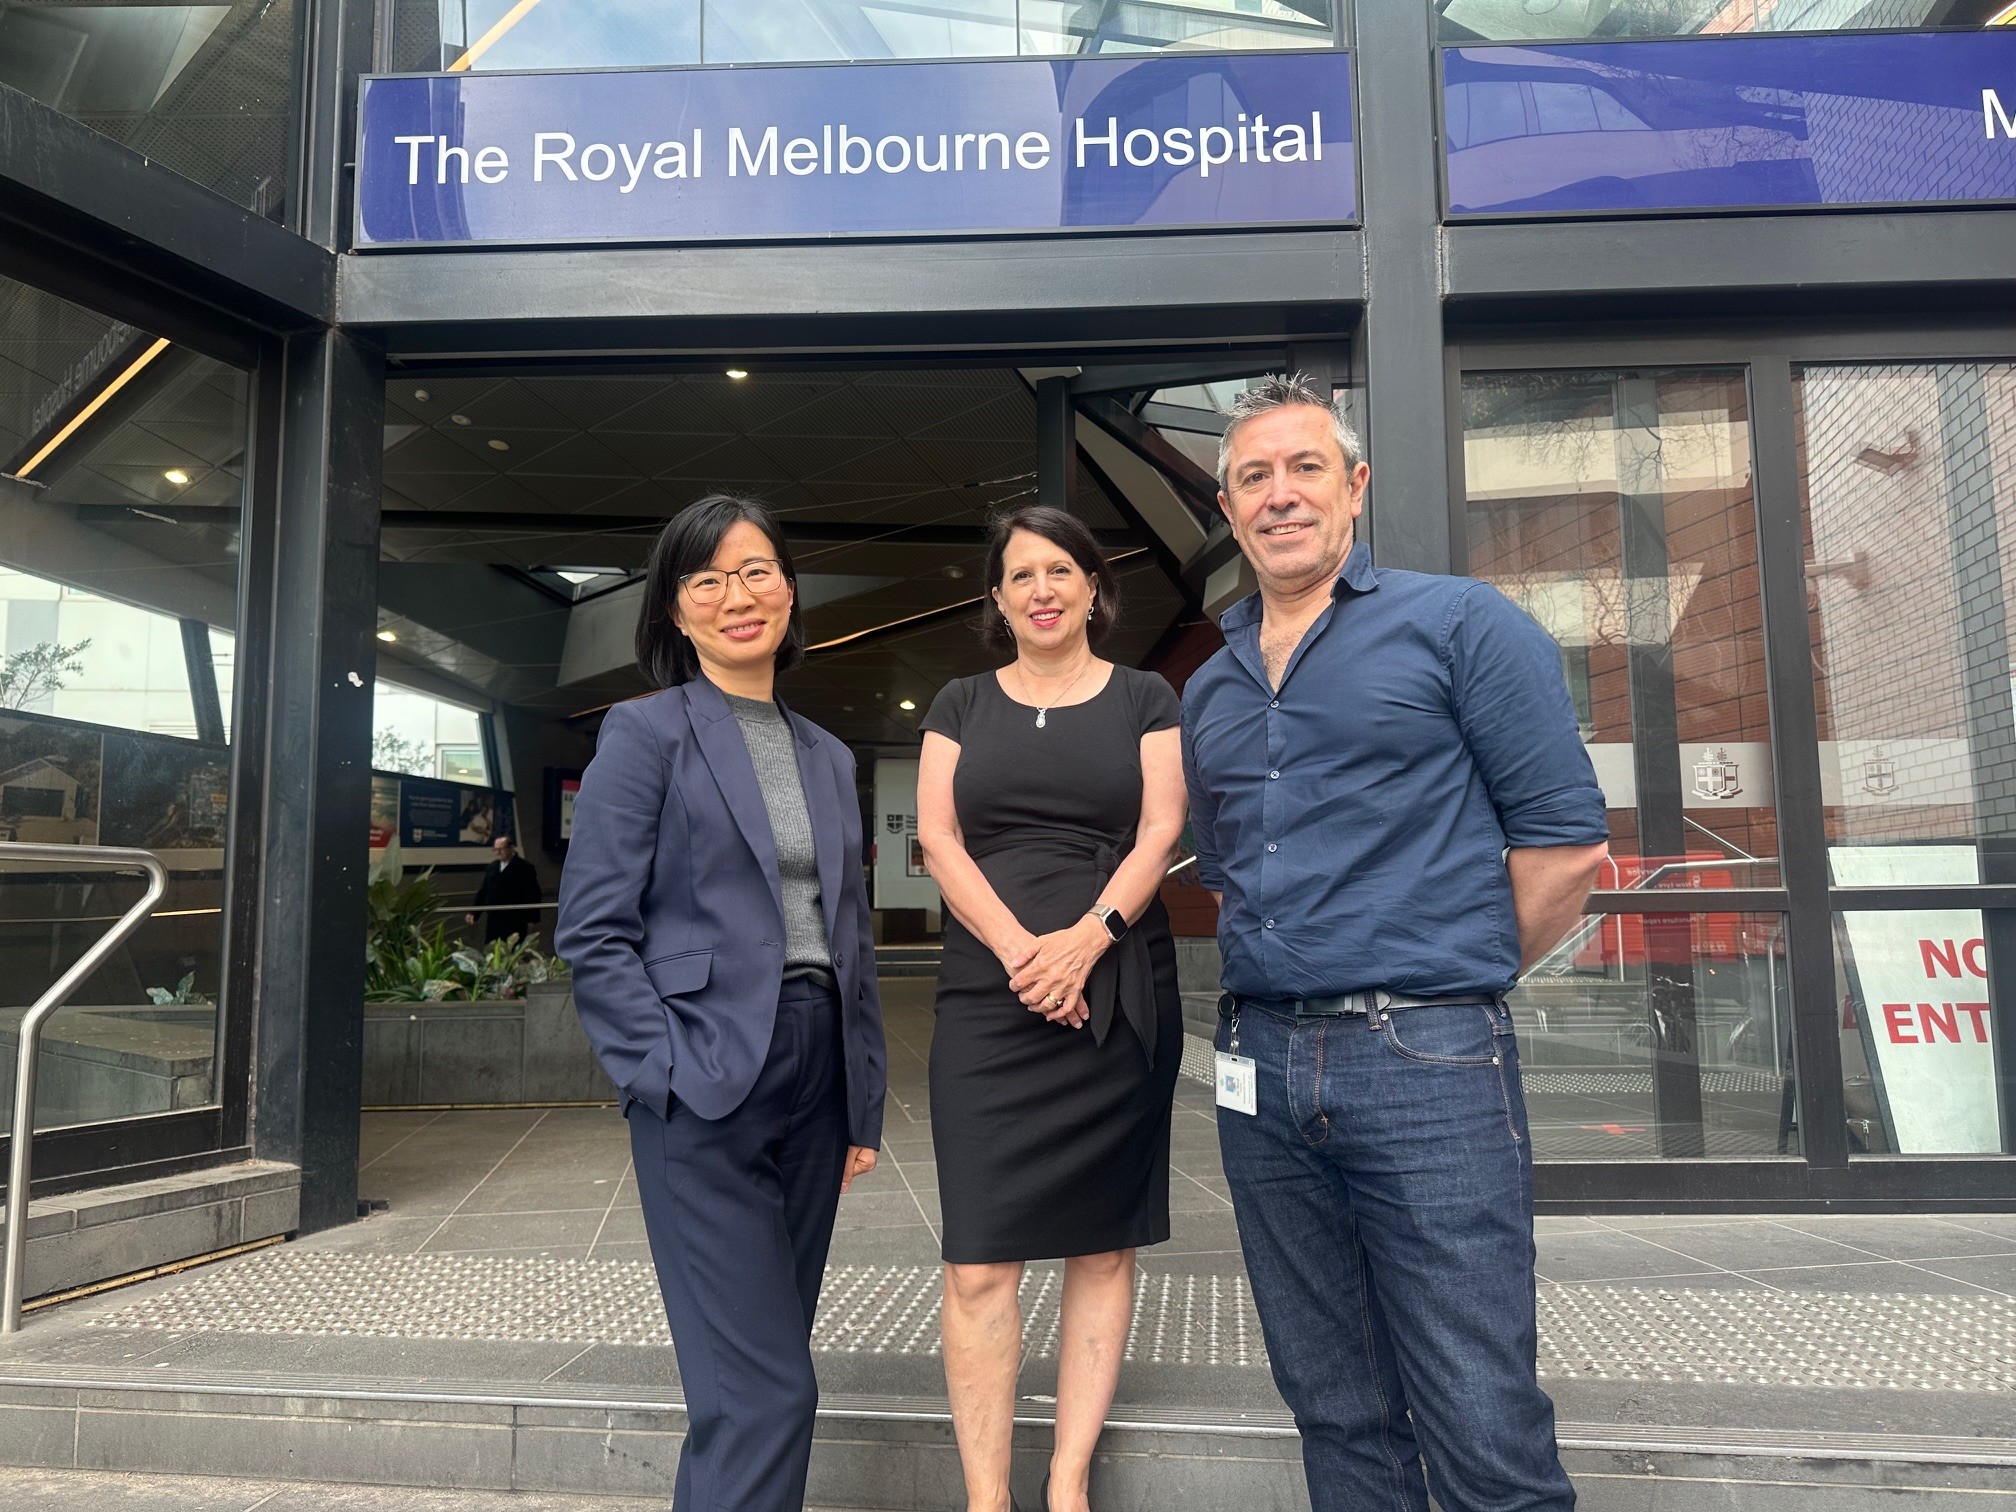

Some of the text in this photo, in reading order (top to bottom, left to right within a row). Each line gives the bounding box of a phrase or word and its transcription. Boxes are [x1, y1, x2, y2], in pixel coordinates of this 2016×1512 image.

[1981, 88, 2016, 139] M
[394, 110, 1322, 194] The Royal Melbourne Hospital
